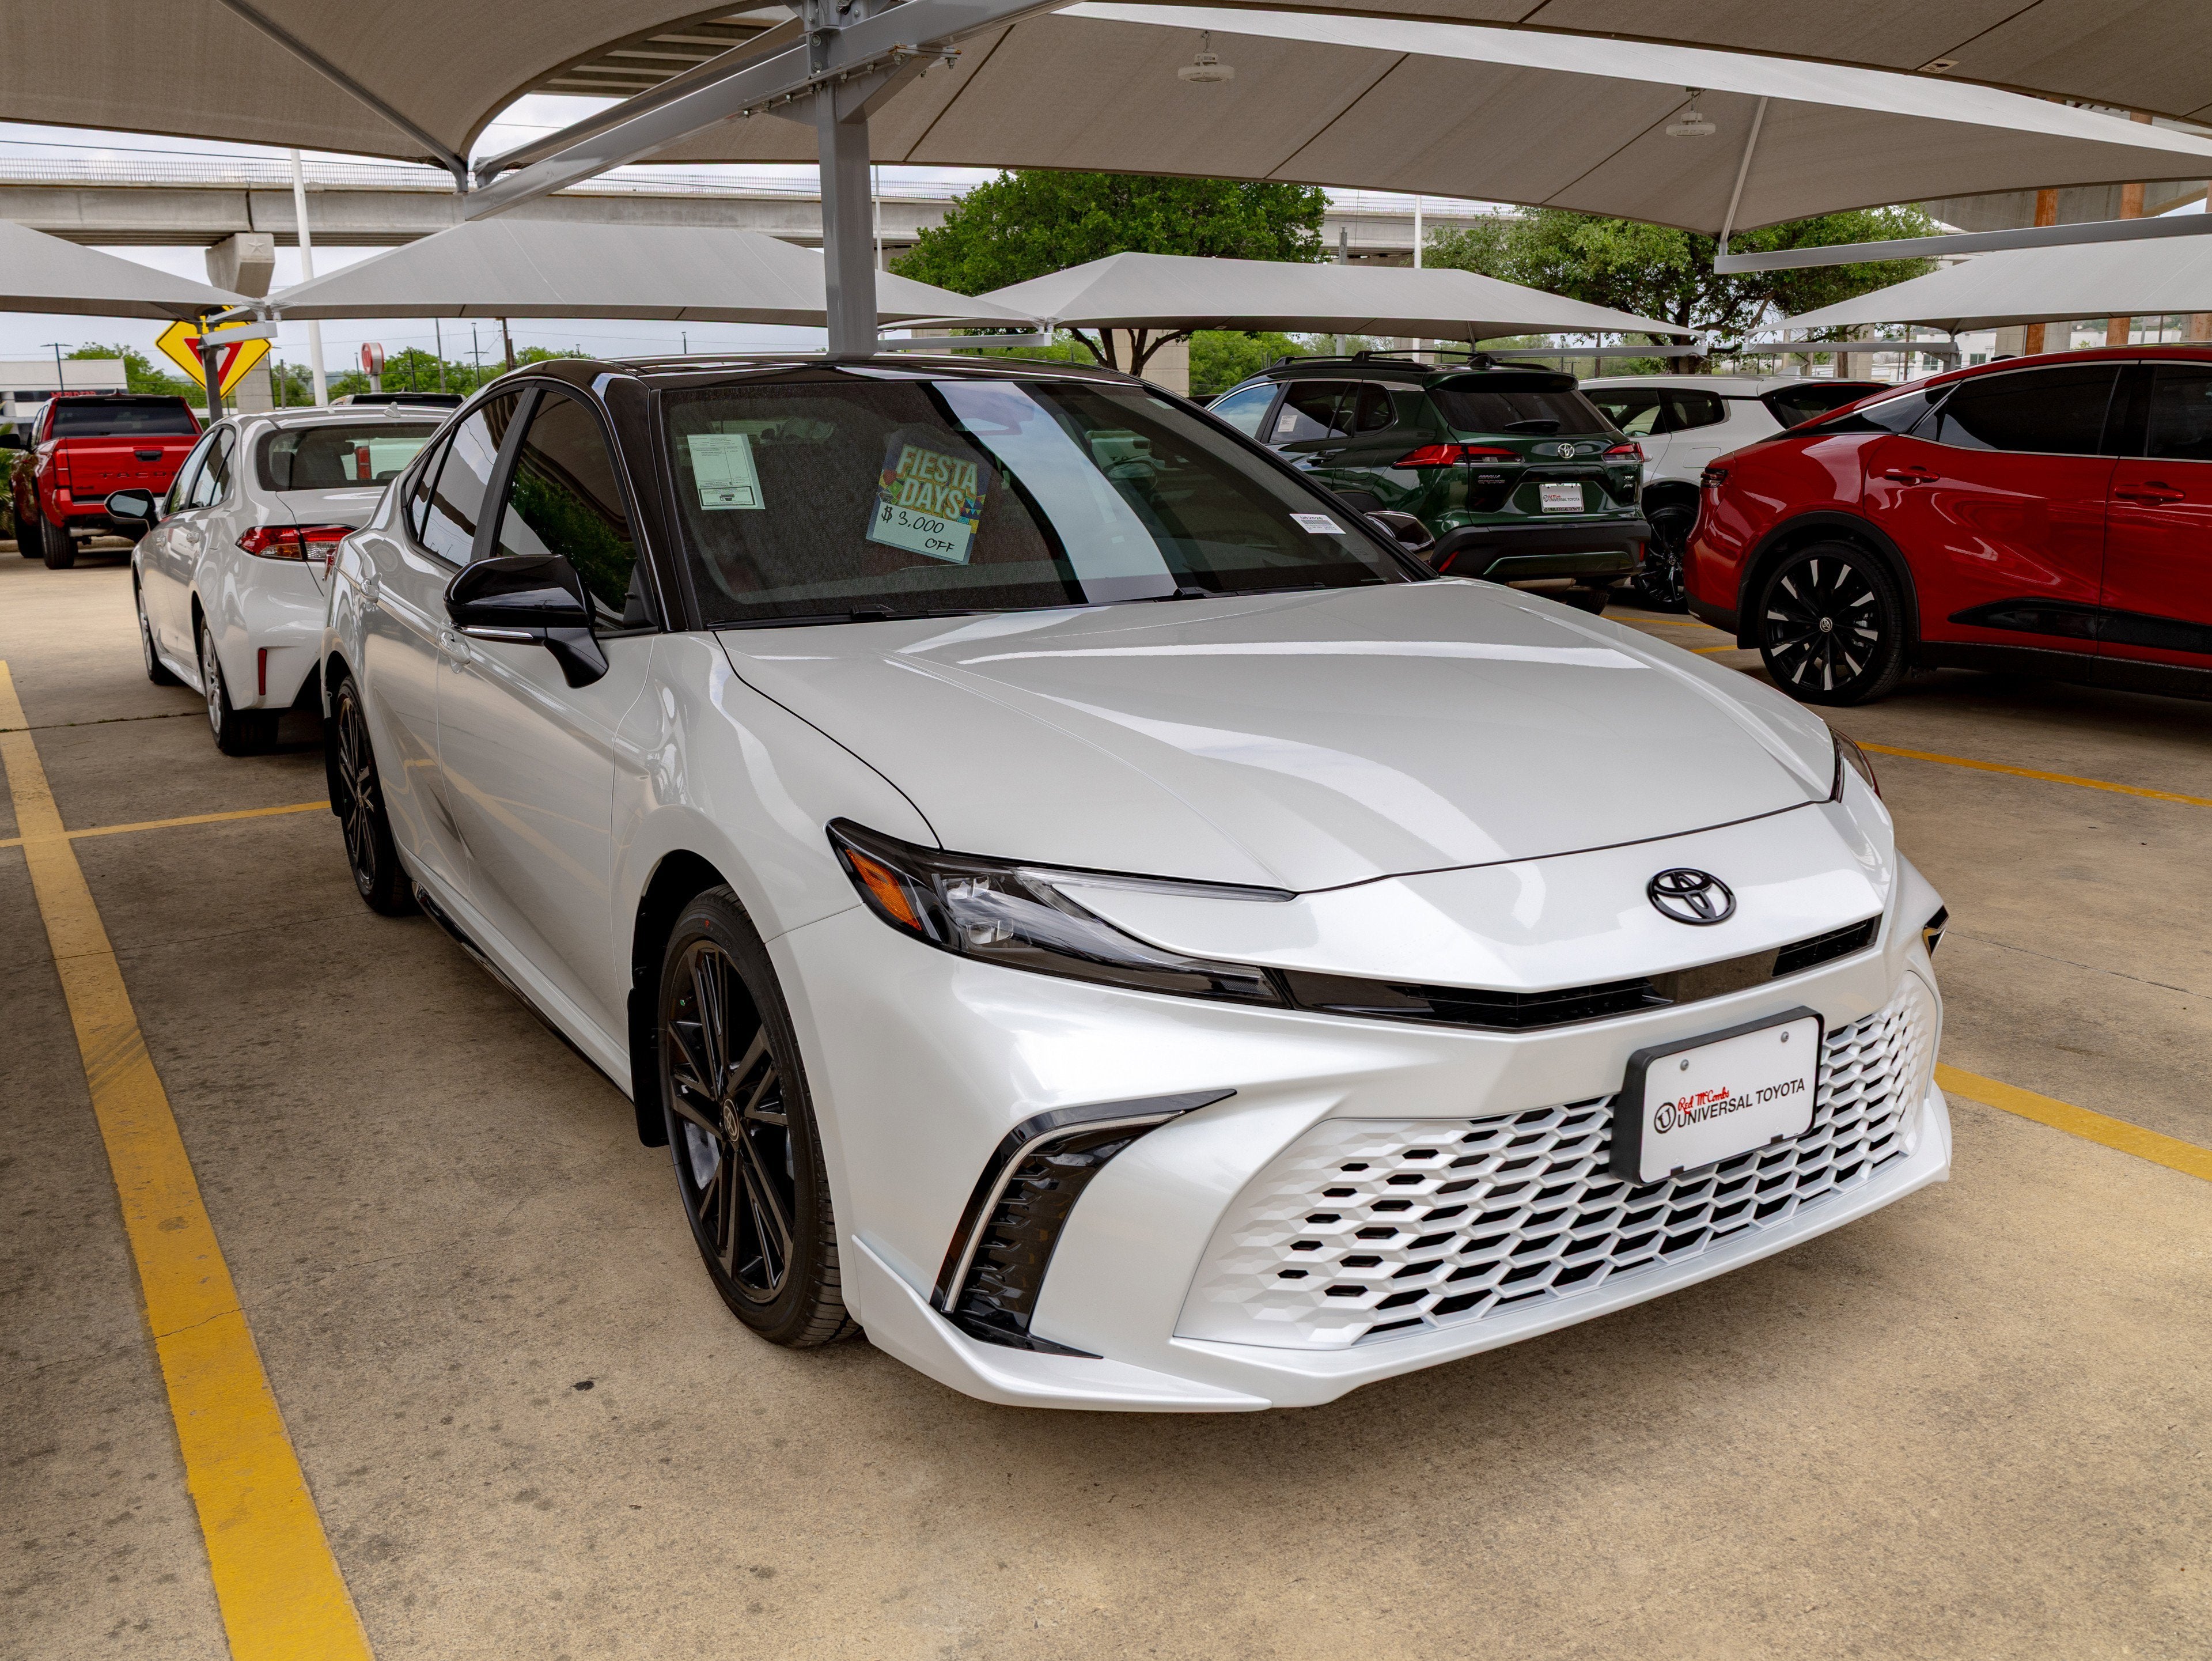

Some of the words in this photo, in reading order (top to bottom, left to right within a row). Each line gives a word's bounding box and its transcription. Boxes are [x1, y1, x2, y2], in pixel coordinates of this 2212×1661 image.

[896, 444, 978, 498] FIESTA
[881, 505, 892, 523] $
[899, 477, 964, 520] DAYS
[925, 538, 955, 552] OFF
[1677, 1096, 1694, 1114] Red
[1695, 1087, 1729, 1106] McCombs
[1677, 1094, 1752, 1128] UNIVERSAL
[1756, 1077, 1805, 1104] TOYOTA
